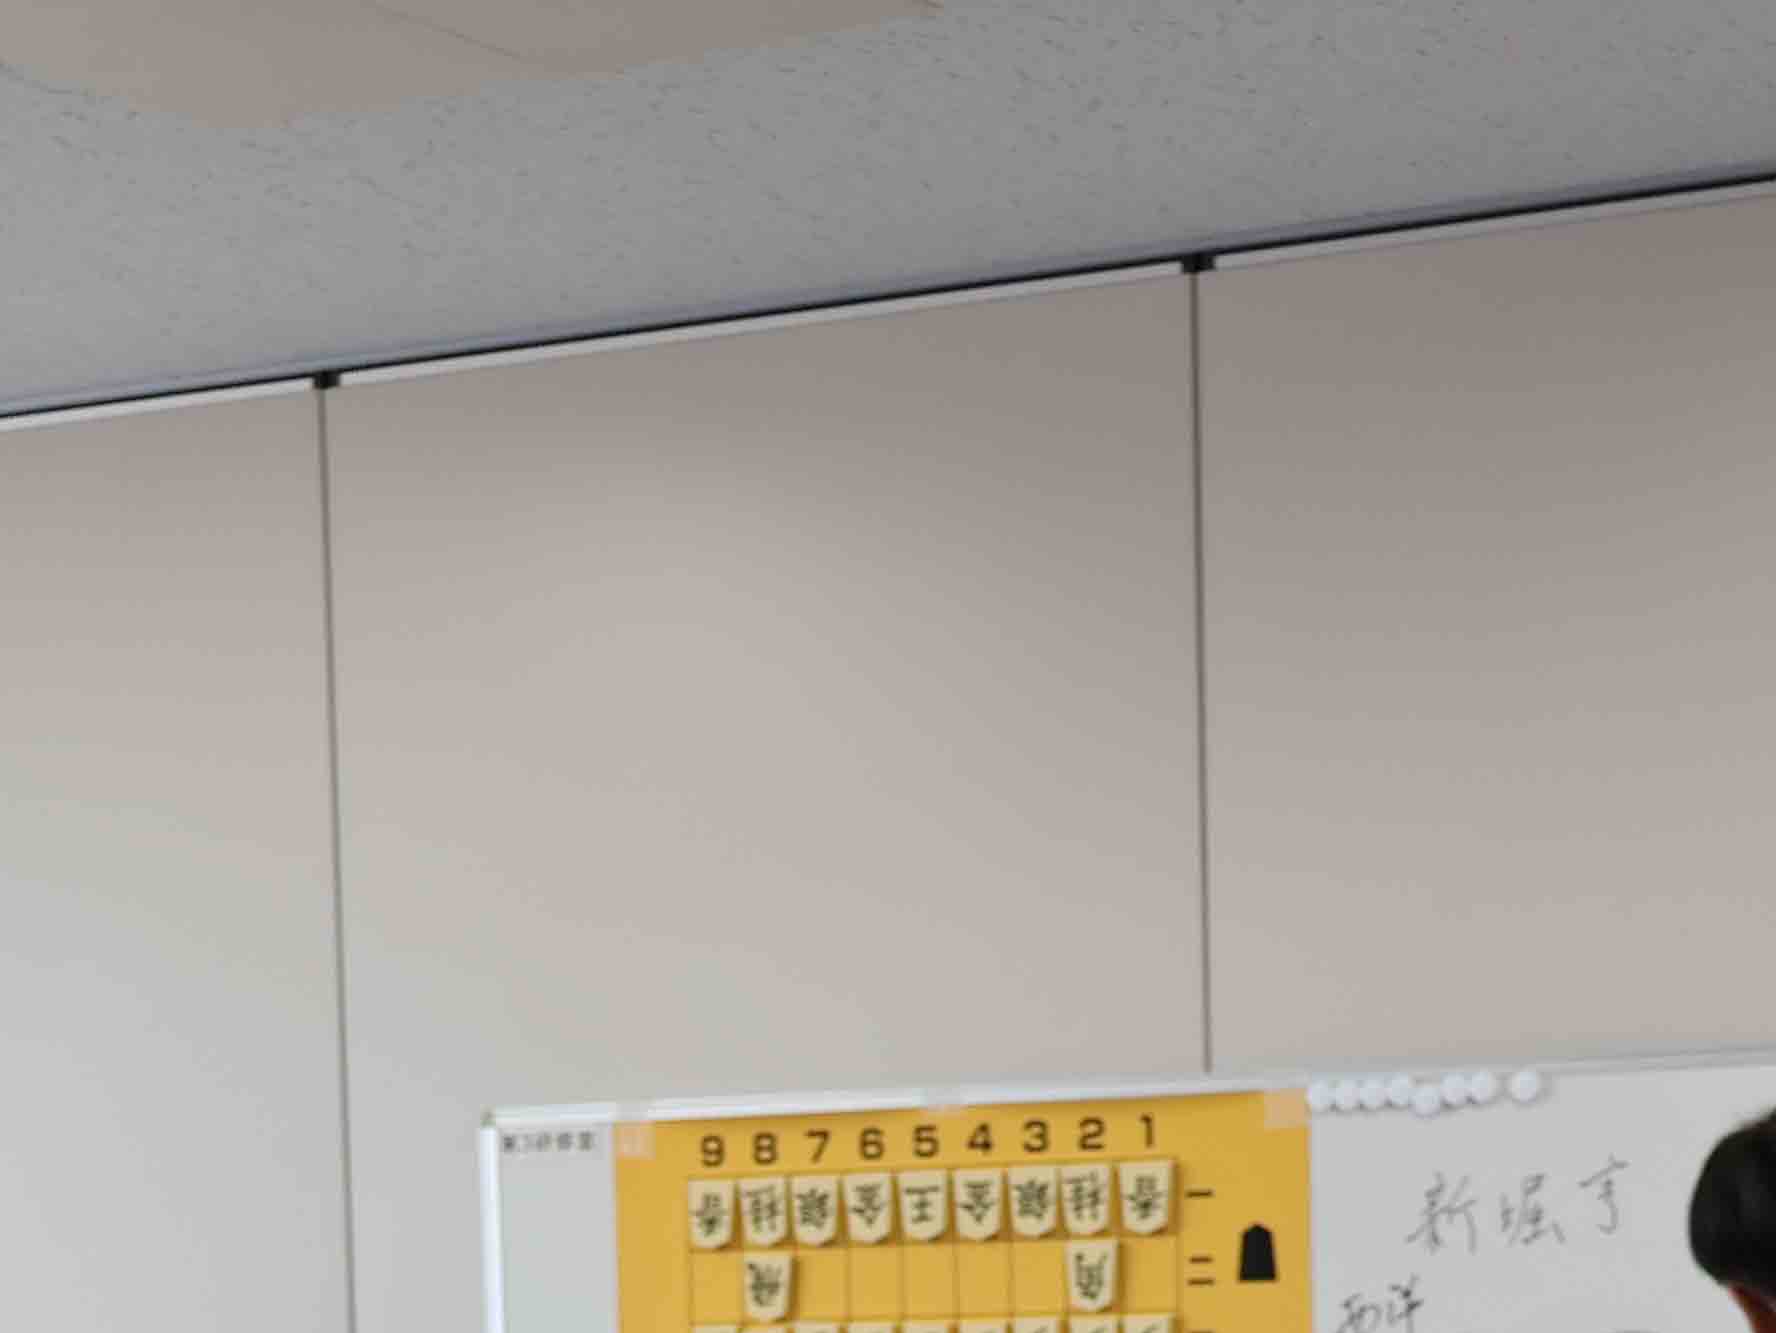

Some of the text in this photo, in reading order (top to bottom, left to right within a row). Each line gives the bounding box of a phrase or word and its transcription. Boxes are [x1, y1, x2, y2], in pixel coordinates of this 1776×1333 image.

[701, 1114, 1153, 1168] 9 8 7 6 5 4 3 2 1
[1188, 1256, 1214, 1286] 二
